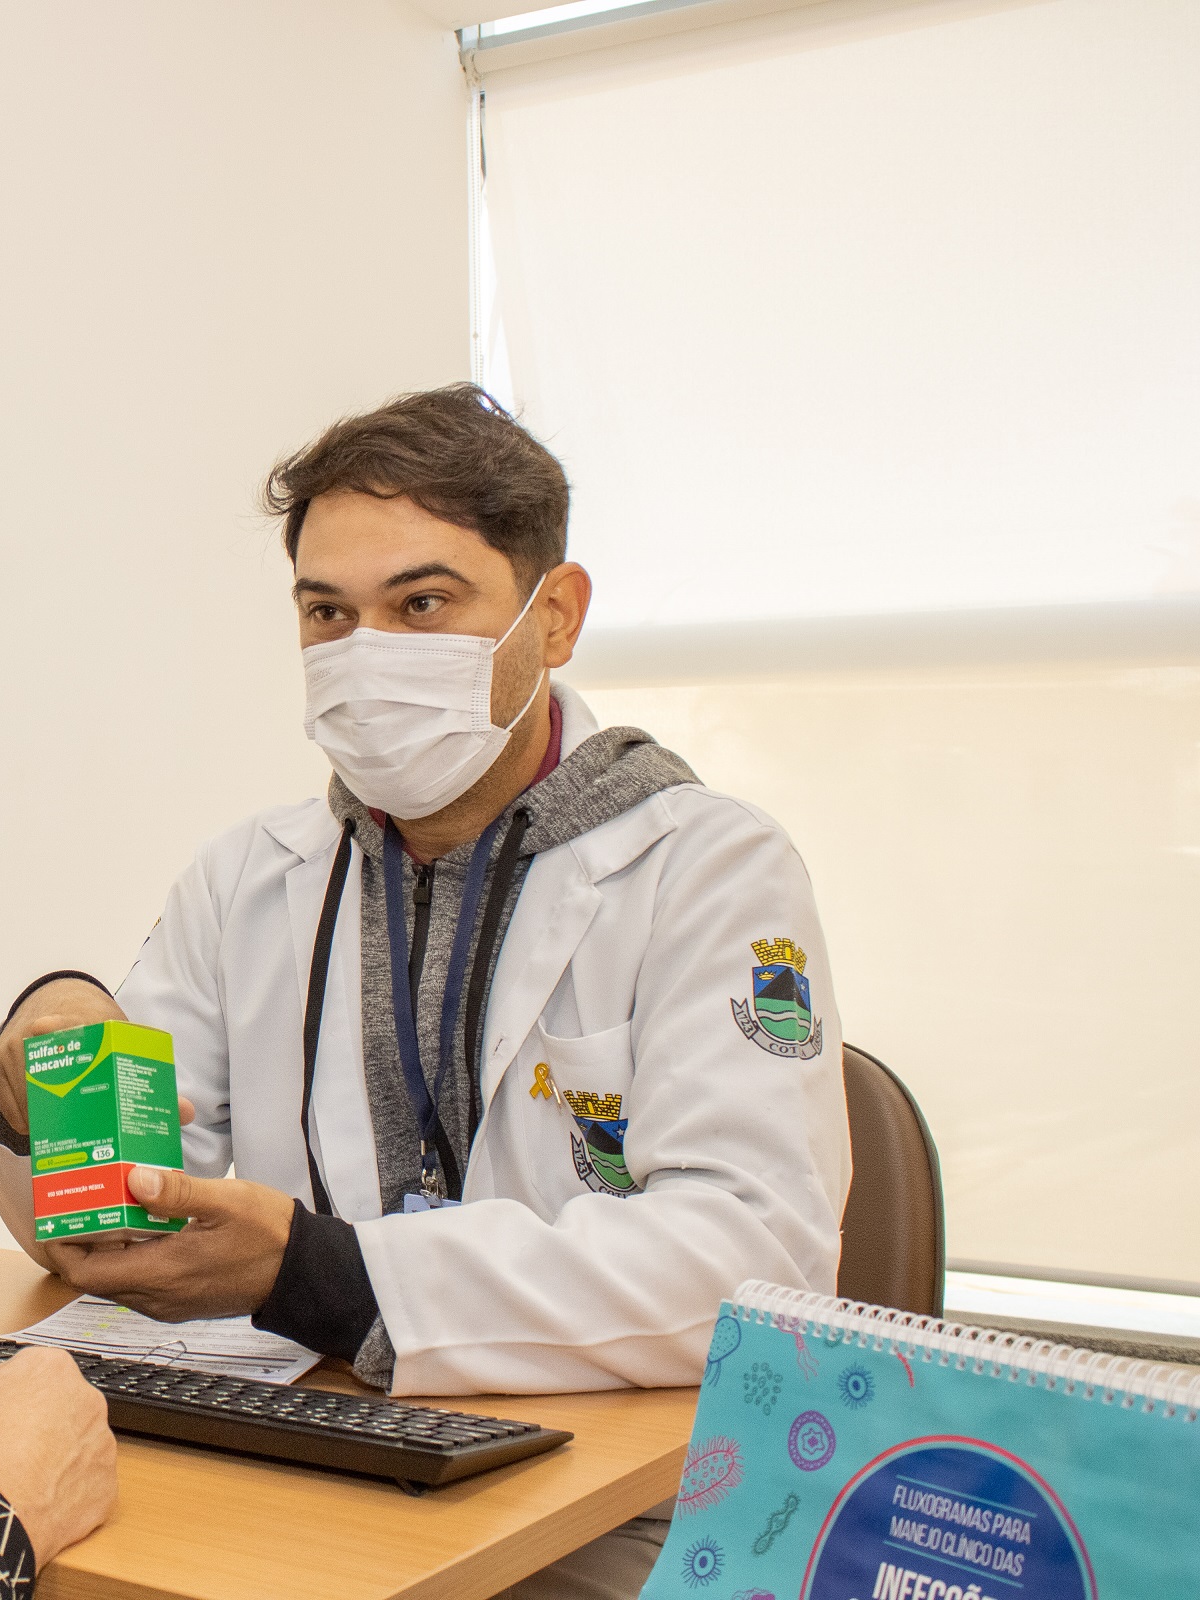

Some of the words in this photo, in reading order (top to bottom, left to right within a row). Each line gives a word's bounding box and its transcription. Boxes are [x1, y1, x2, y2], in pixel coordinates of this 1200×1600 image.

[736, 1010, 753, 1033] 1723
[28, 1045, 65, 1060] sulfato
[67, 1040, 81, 1052] de
[29, 1055, 75, 1074] abacavir
[96, 1149, 111, 1159] 136
[574, 1149, 587, 1174] 1723
[97, 1211, 121, 1219] Governo
[100, 1217, 121, 1225] Federal
[892, 1484, 993, 1533] FLUXOGRAMAS
[991, 1513, 1031, 1545] PARA
[889, 1515, 942, 1551] MANEJO
[941, 1532, 993, 1567] CLÍNICO
[992, 1546, 1025, 1577] DAS
[872, 1562, 998, 1600] INFEC
